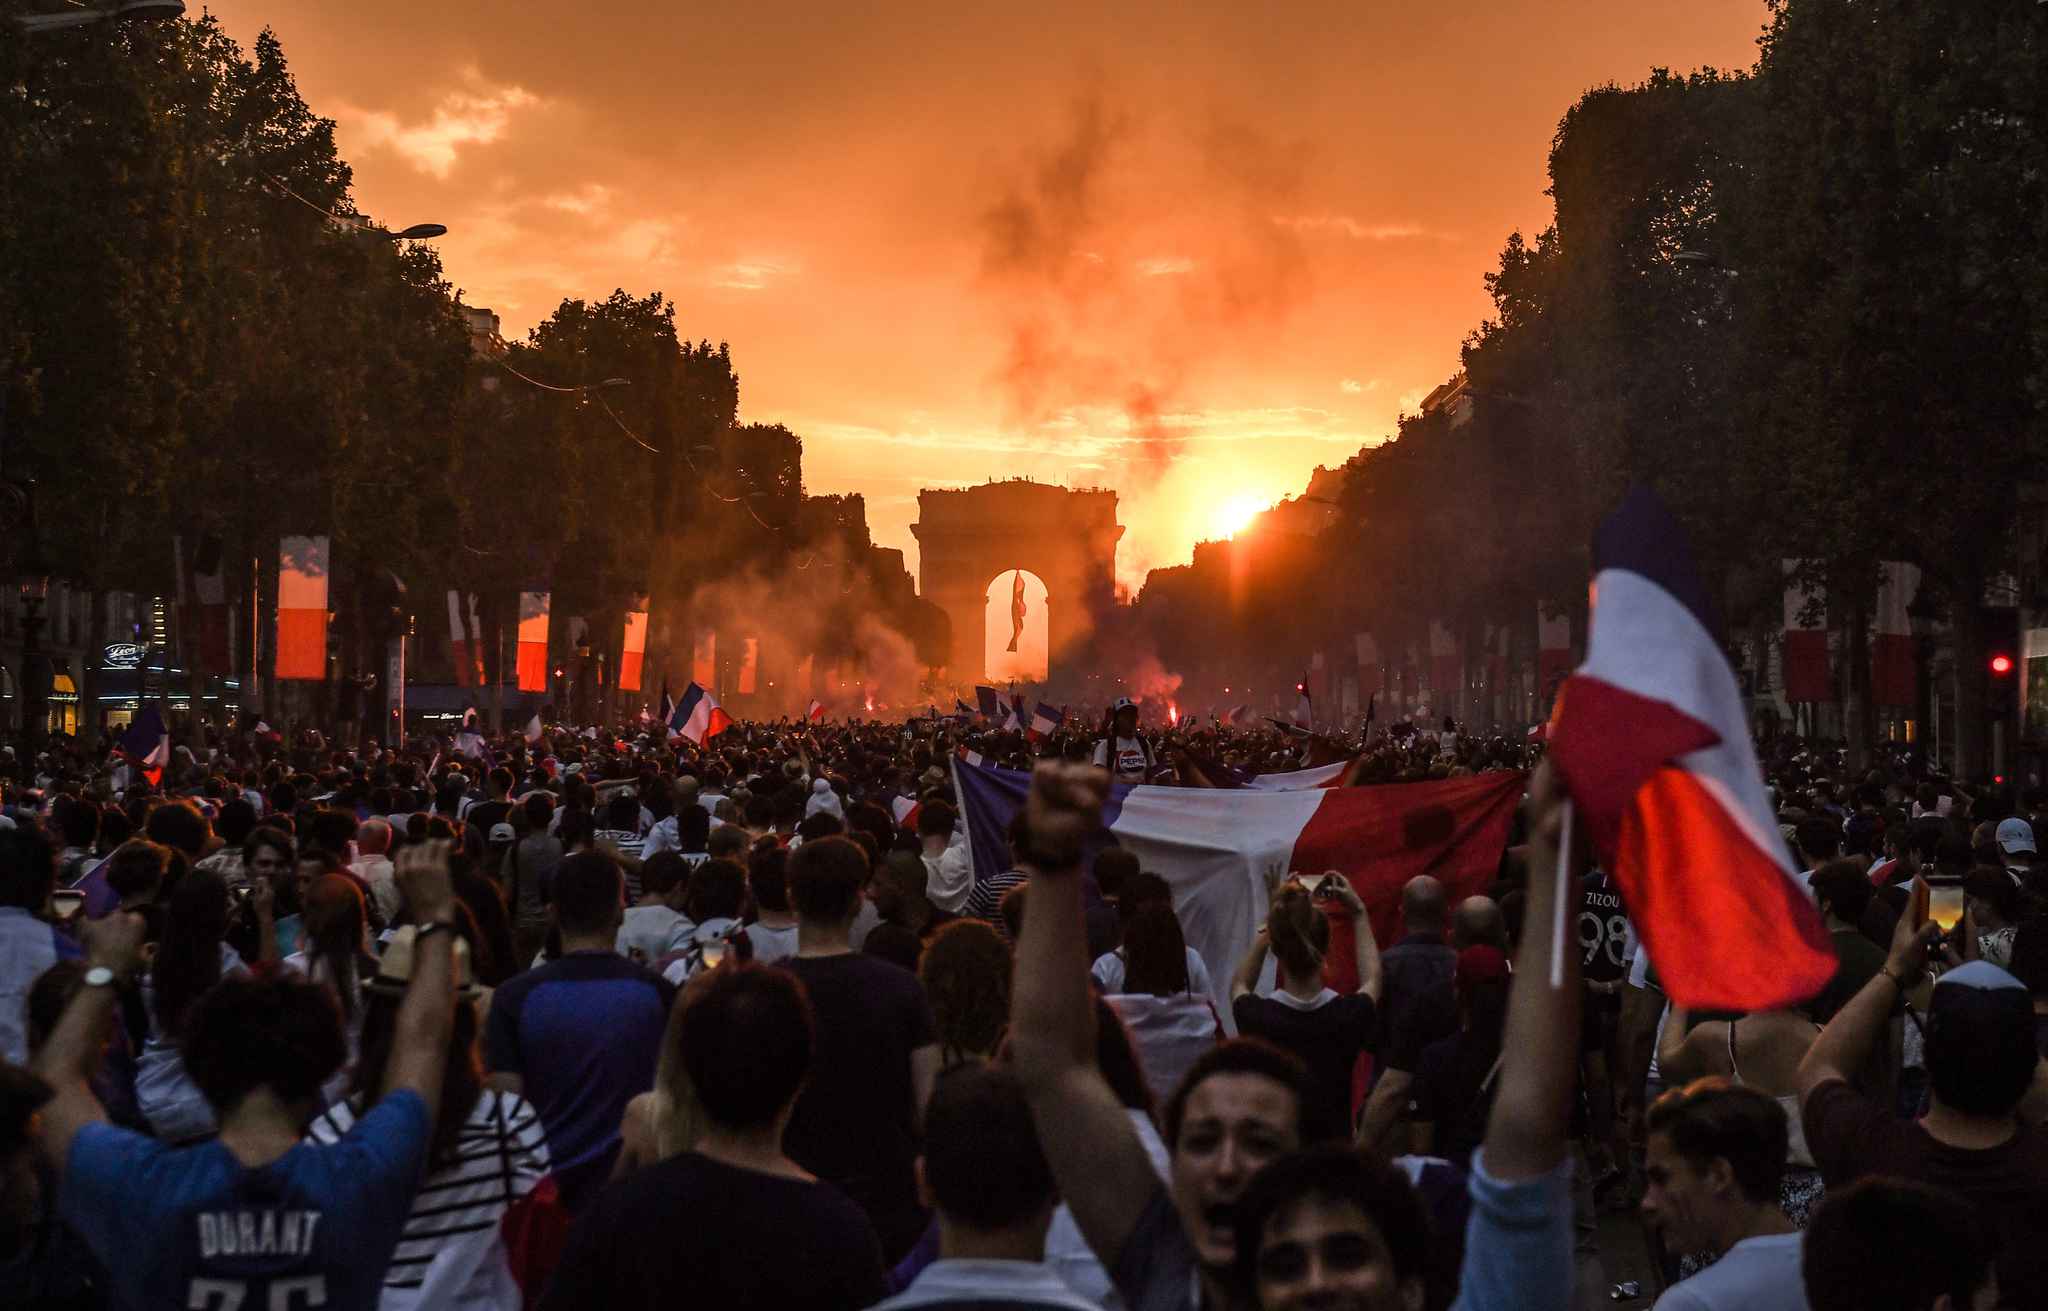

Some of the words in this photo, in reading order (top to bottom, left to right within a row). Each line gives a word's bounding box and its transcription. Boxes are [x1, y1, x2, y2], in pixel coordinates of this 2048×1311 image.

[1585, 892, 1620, 908] ZIZOU
[1577, 912, 1626, 967] 98
[196, 1210, 322, 1257] DURANT
